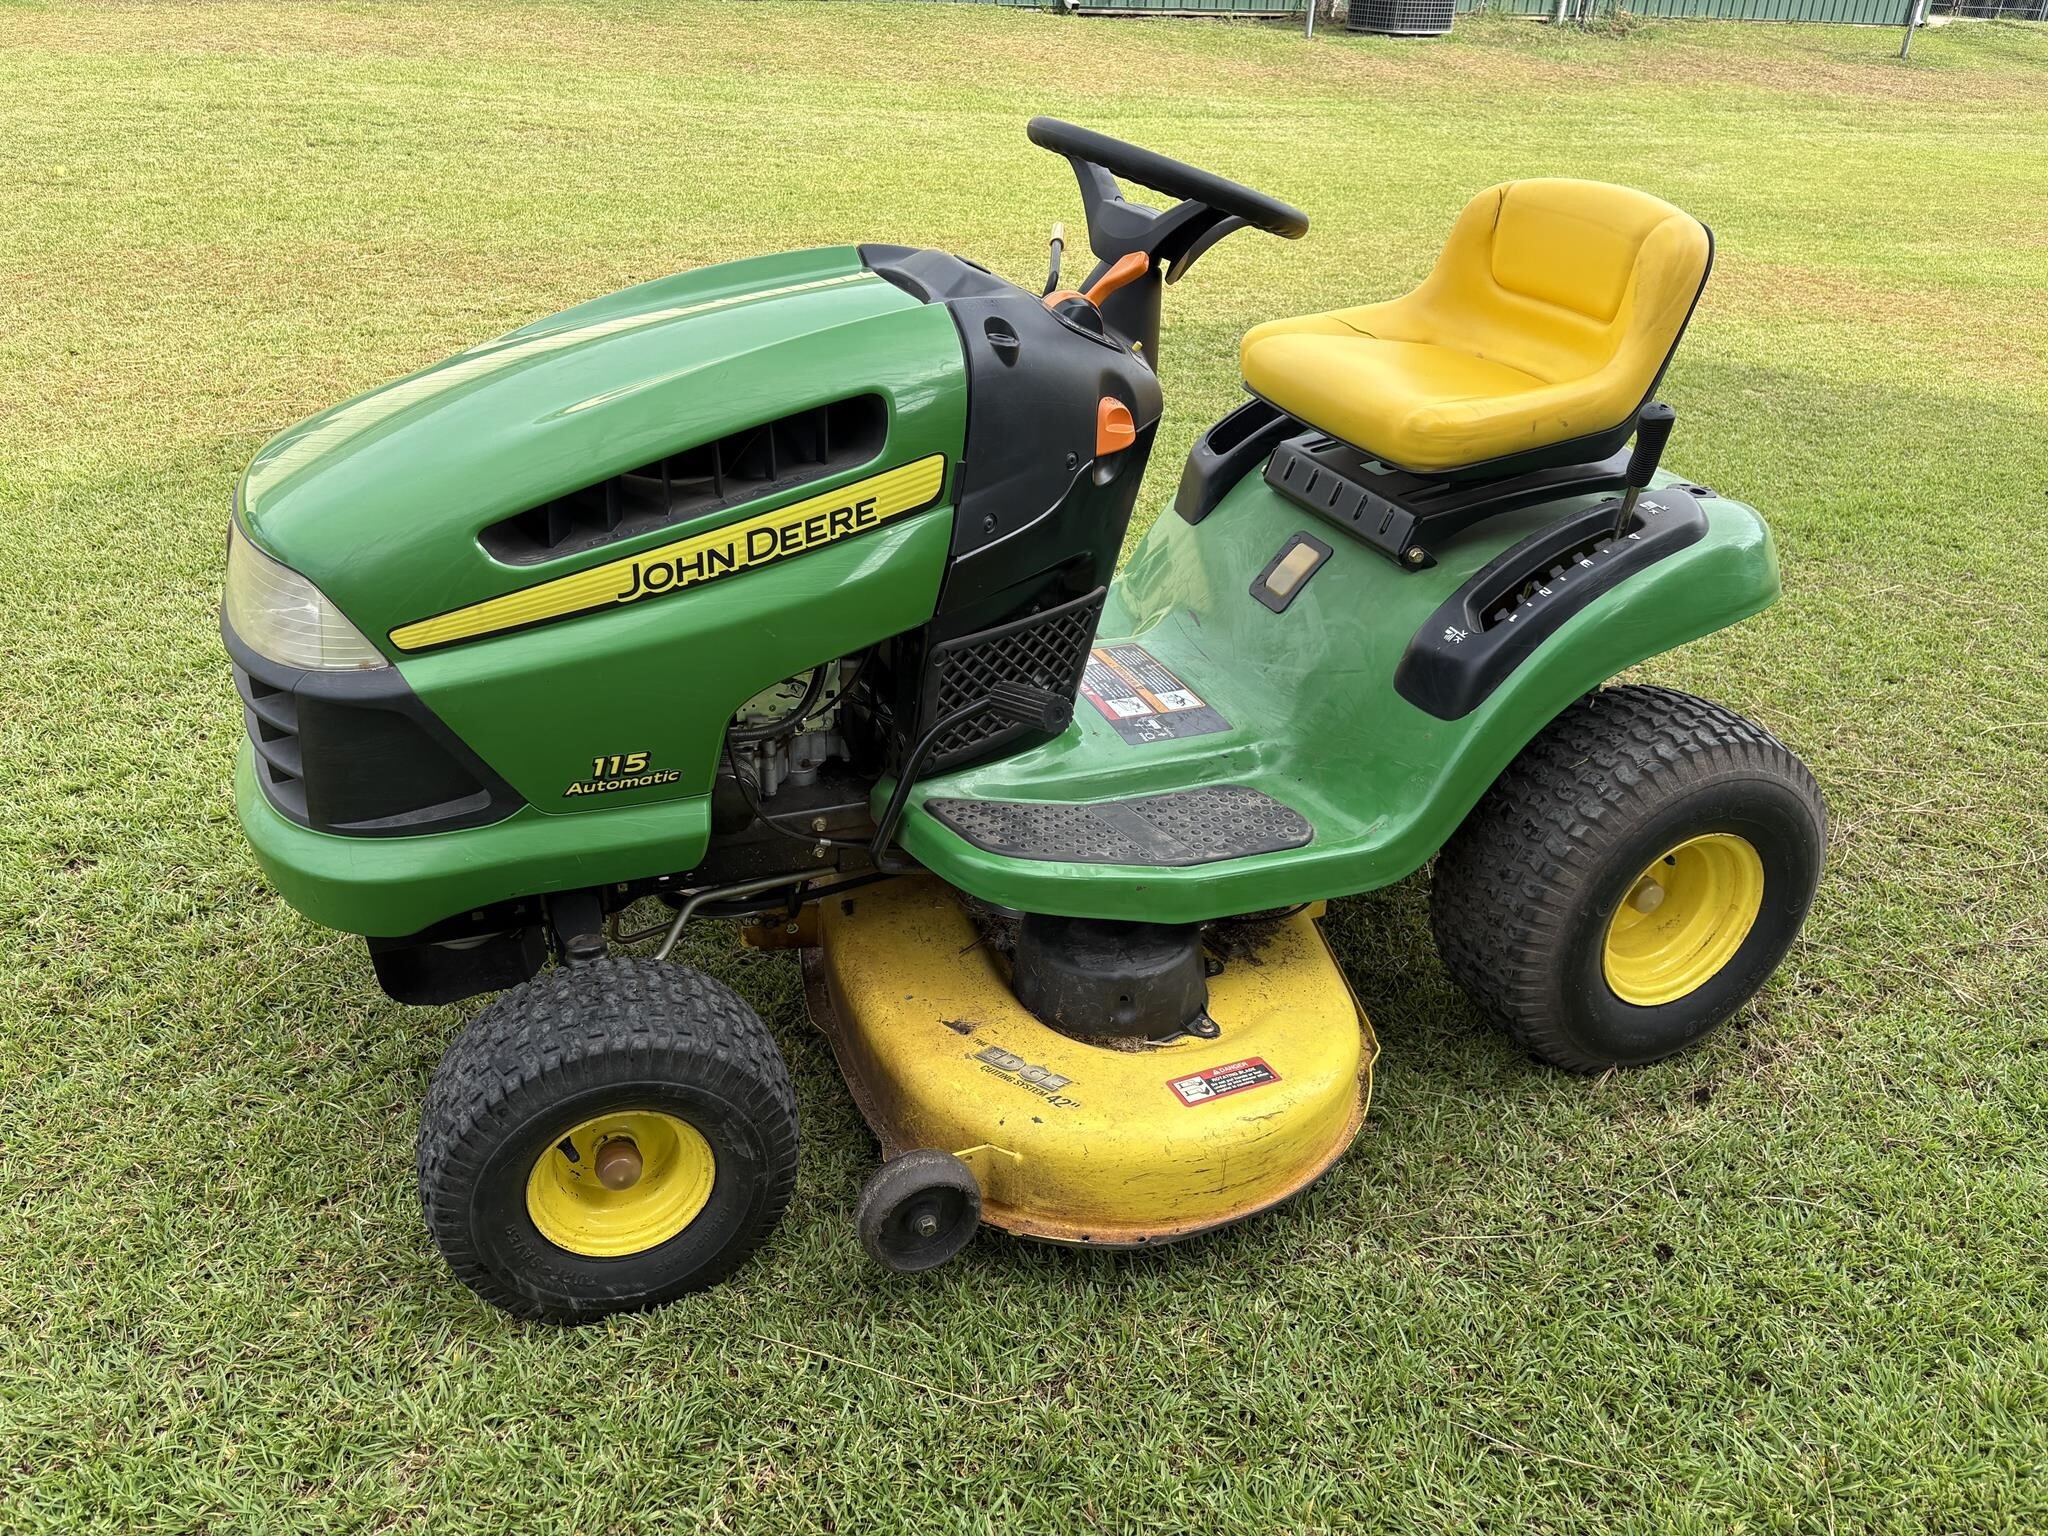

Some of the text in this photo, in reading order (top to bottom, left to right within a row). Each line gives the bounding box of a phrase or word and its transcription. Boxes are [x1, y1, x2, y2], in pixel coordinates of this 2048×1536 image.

[617, 496, 878, 600] JOHN DEERE
[1580, 558, 1595, 568] 3
[1538, 586, 1553, 597] 2
[1508, 614, 1518, 623] 1
[593, 752, 648, 777] 115
[565, 770, 680, 795] Automatic
[973, 1038, 990, 1048] THE
[973, 1044, 1073, 1092] EDGE
[1219, 1061, 1248, 1074] DANGER
[980, 1065, 1081, 1109] CUTTING SYSTEM 42"
